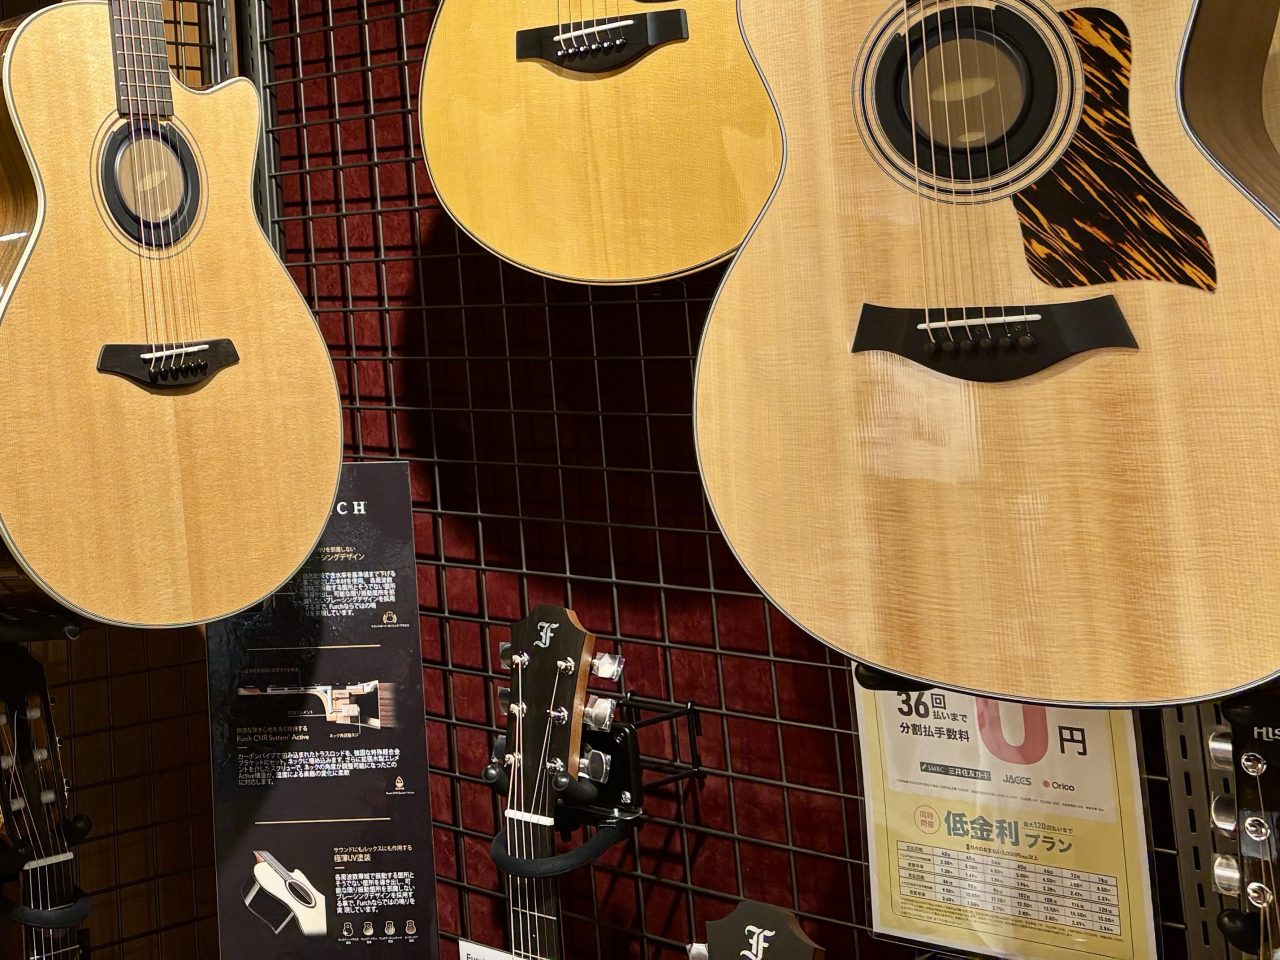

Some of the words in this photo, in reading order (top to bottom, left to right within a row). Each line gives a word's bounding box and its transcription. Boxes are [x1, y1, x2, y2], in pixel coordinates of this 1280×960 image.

[897, 690, 929, 719] 36
[932, 694, 946, 709] 回
[932, 710, 968, 723] 払いまで
[899, 723, 970, 743] 分割払手数料
[1058, 726, 1087, 756] 円
[1003, 774, 1032, 786] JACCS
[1052, 782, 1074, 792] Orico
[944, 810, 1019, 846] 低金利
[1025, 834, 1072, 852] プラン
